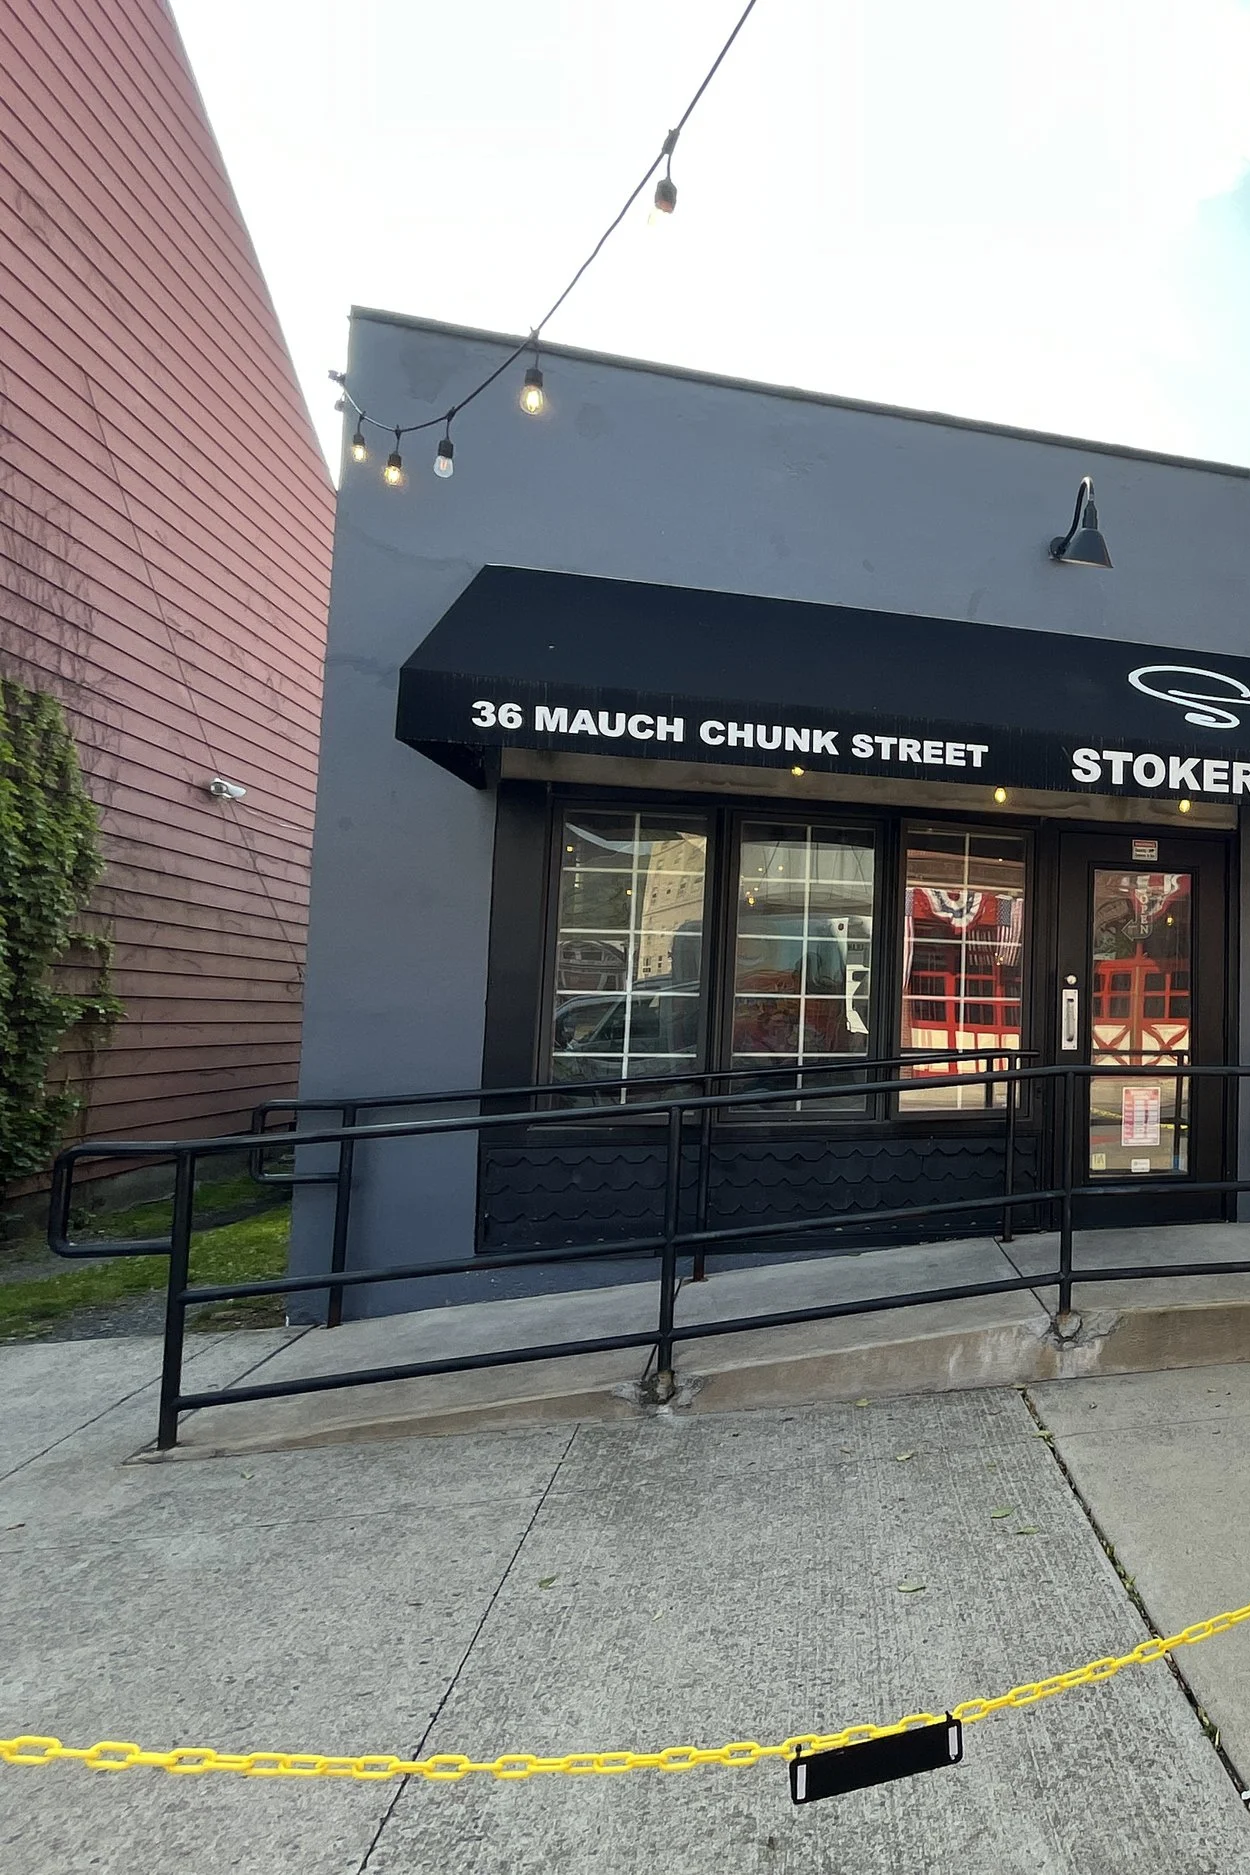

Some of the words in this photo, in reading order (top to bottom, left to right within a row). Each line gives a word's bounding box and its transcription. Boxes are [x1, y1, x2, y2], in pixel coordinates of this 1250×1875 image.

[471, 700, 523, 729] 36
[534, 705, 684, 743] MAUCH
[699, 720, 840, 756] CHUNK
[851, 733, 989, 768] STREET
[1140, 894, 1149, 935] OPEN
